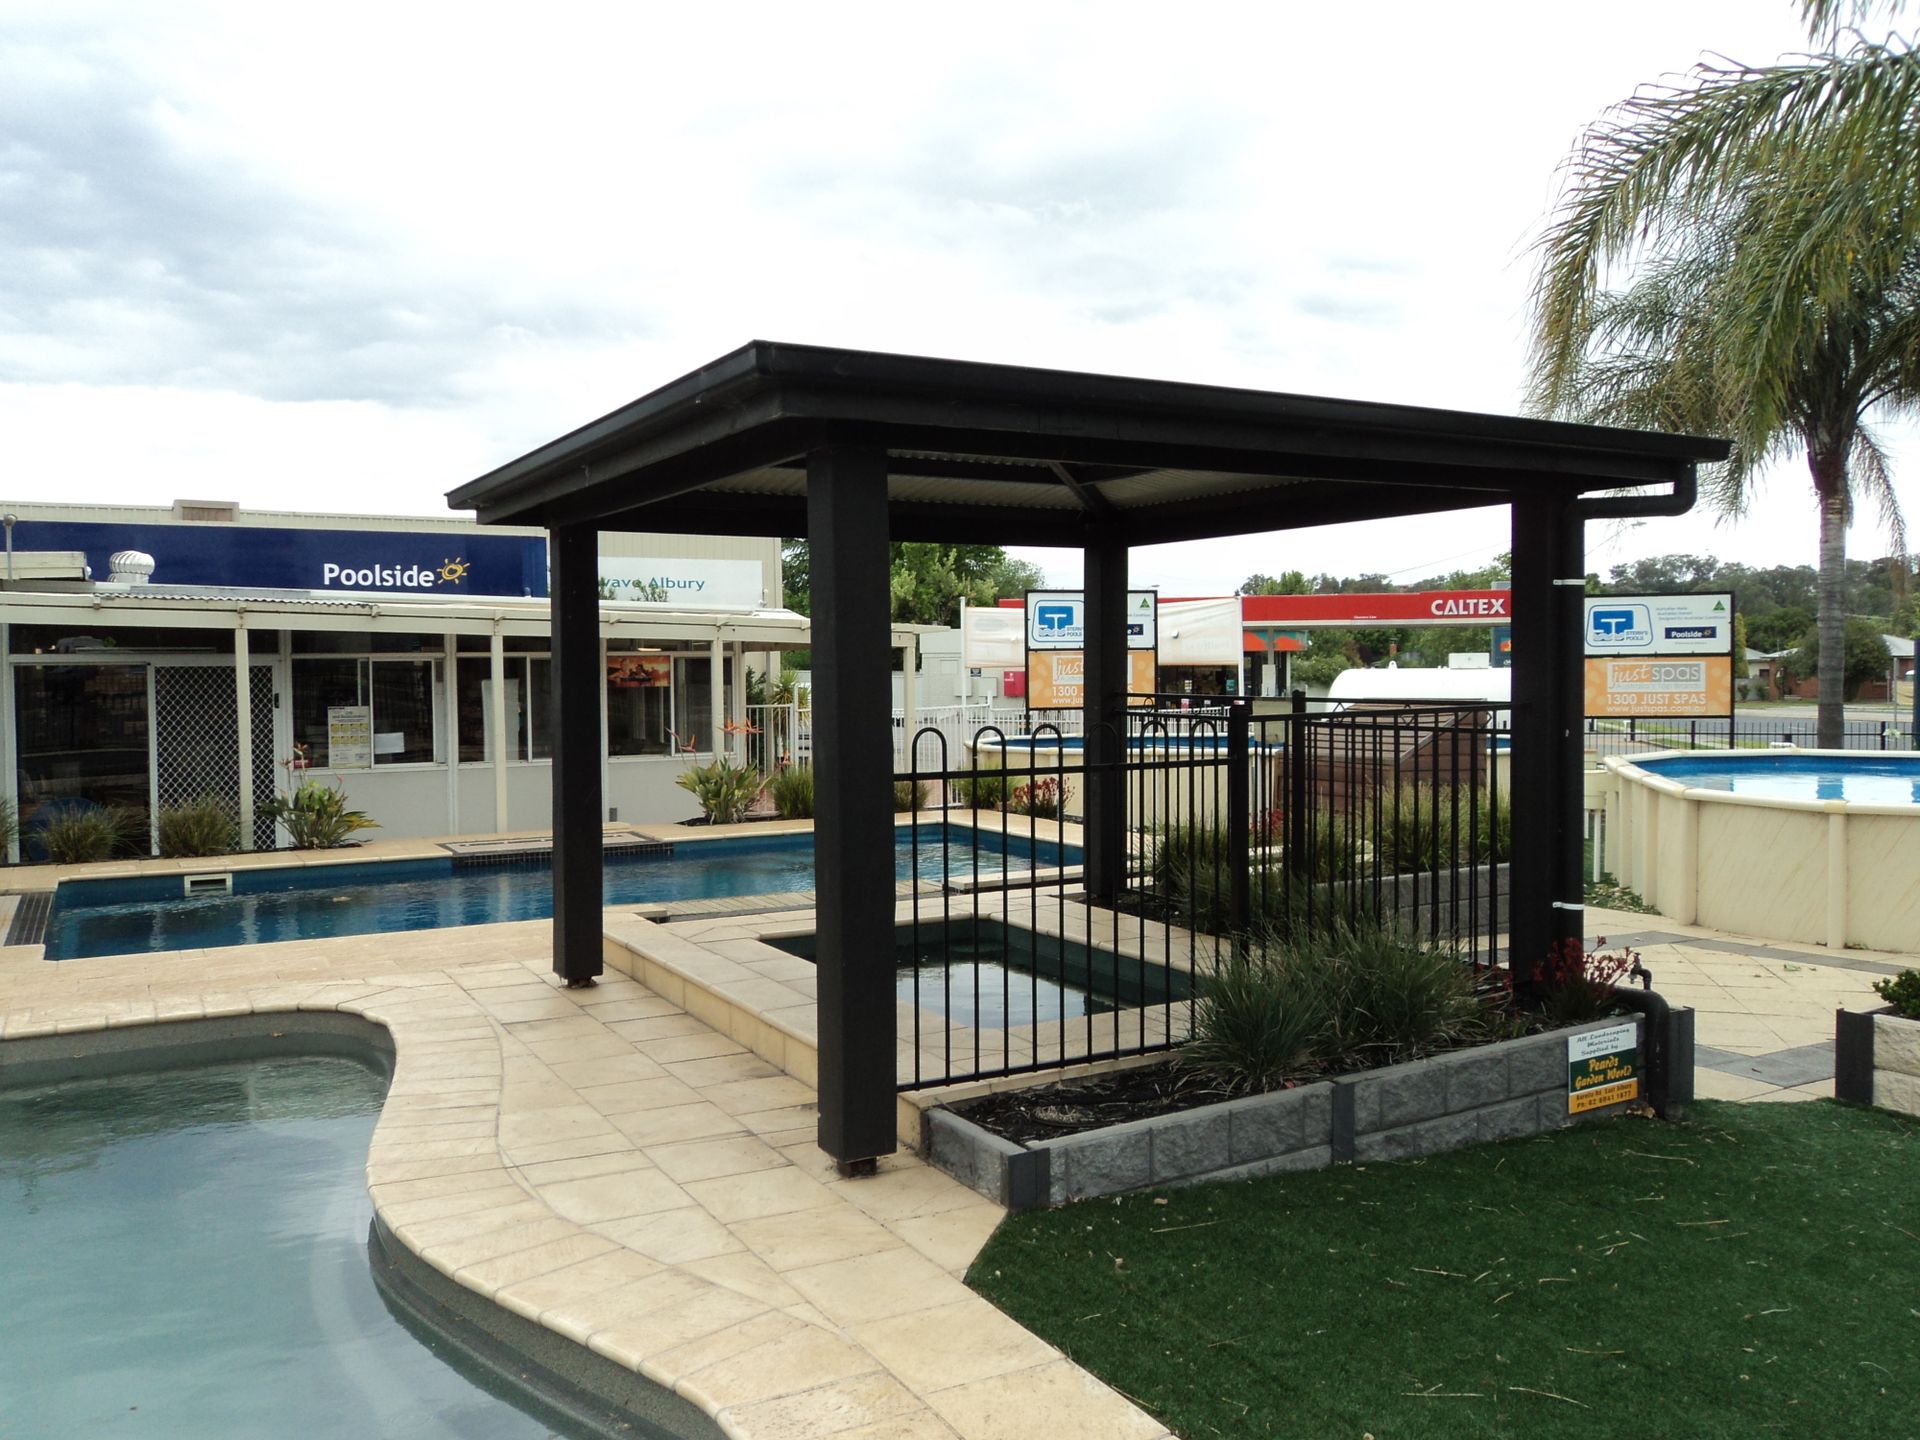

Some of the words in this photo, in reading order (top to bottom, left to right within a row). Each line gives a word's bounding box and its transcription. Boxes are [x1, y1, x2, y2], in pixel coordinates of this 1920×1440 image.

[323, 563, 435, 588] Poolside
[648, 577, 705, 591] Albury
[1431, 599, 1506, 615] CALTEX
[1608, 664, 1651, 688] just
[1652, 666, 1699, 683] spas
[1053, 686, 1077, 696] 1300
[1607, 694, 1637, 704] 1300
[1641, 694, 1670, 704] JUST
[1674, 693, 1706, 704] SPAS
[1575, 1073, 1605, 1089] Garden
[1607, 1065, 1632, 1080] World
